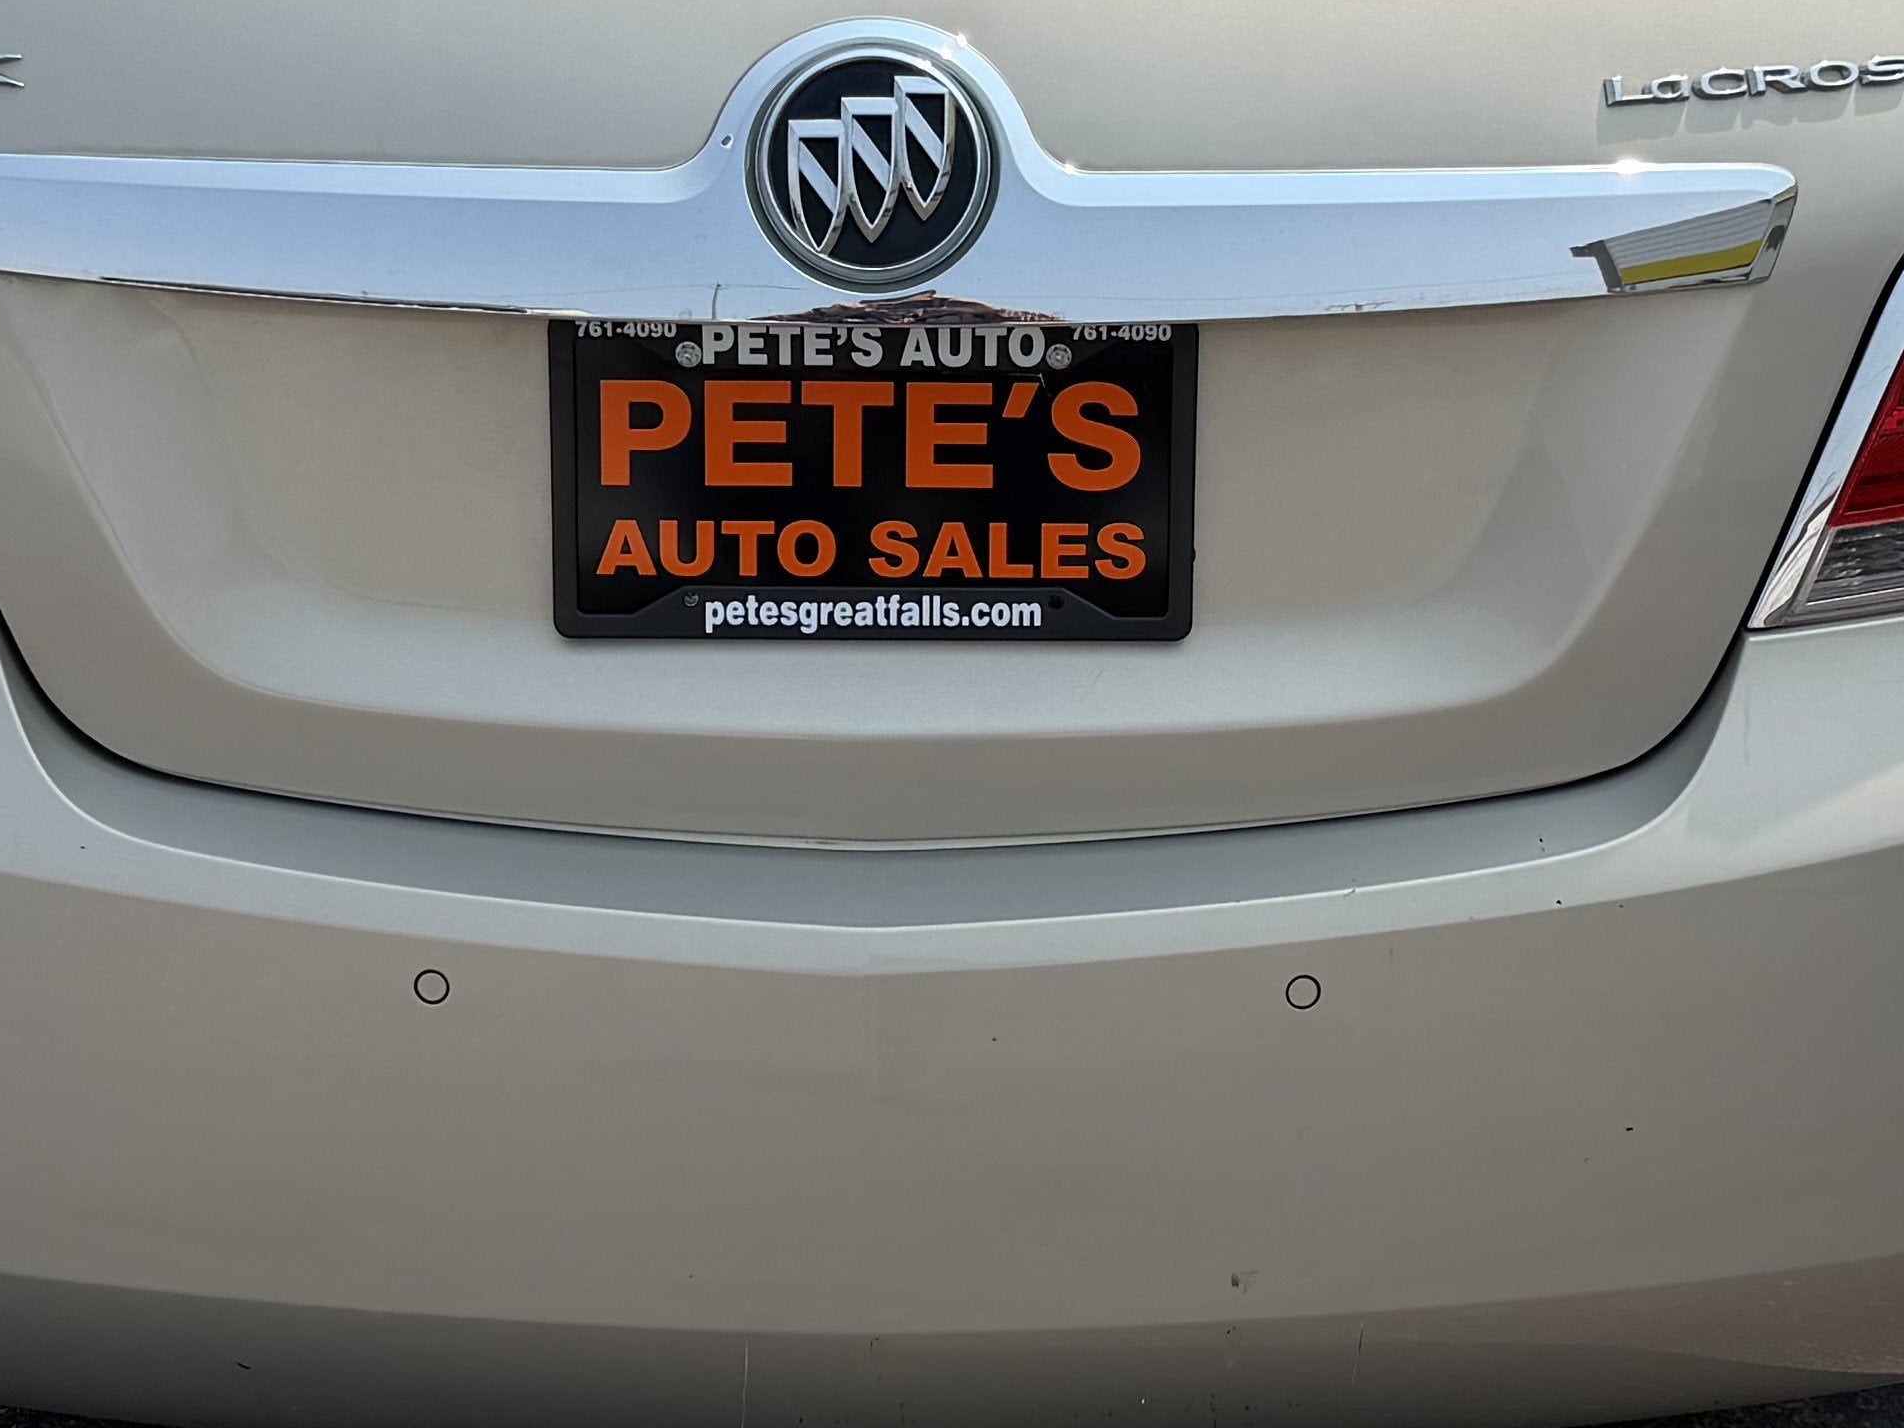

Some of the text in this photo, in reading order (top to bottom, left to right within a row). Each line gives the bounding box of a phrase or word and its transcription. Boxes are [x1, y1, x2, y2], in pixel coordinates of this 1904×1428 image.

[702, 325, 1046, 368] PETE'S AUTO
[599, 378, 1142, 492] PETE'S
[596, 519, 1147, 580] AUTO SALES
[704, 594, 1042, 634] petesgreatfalls.com
